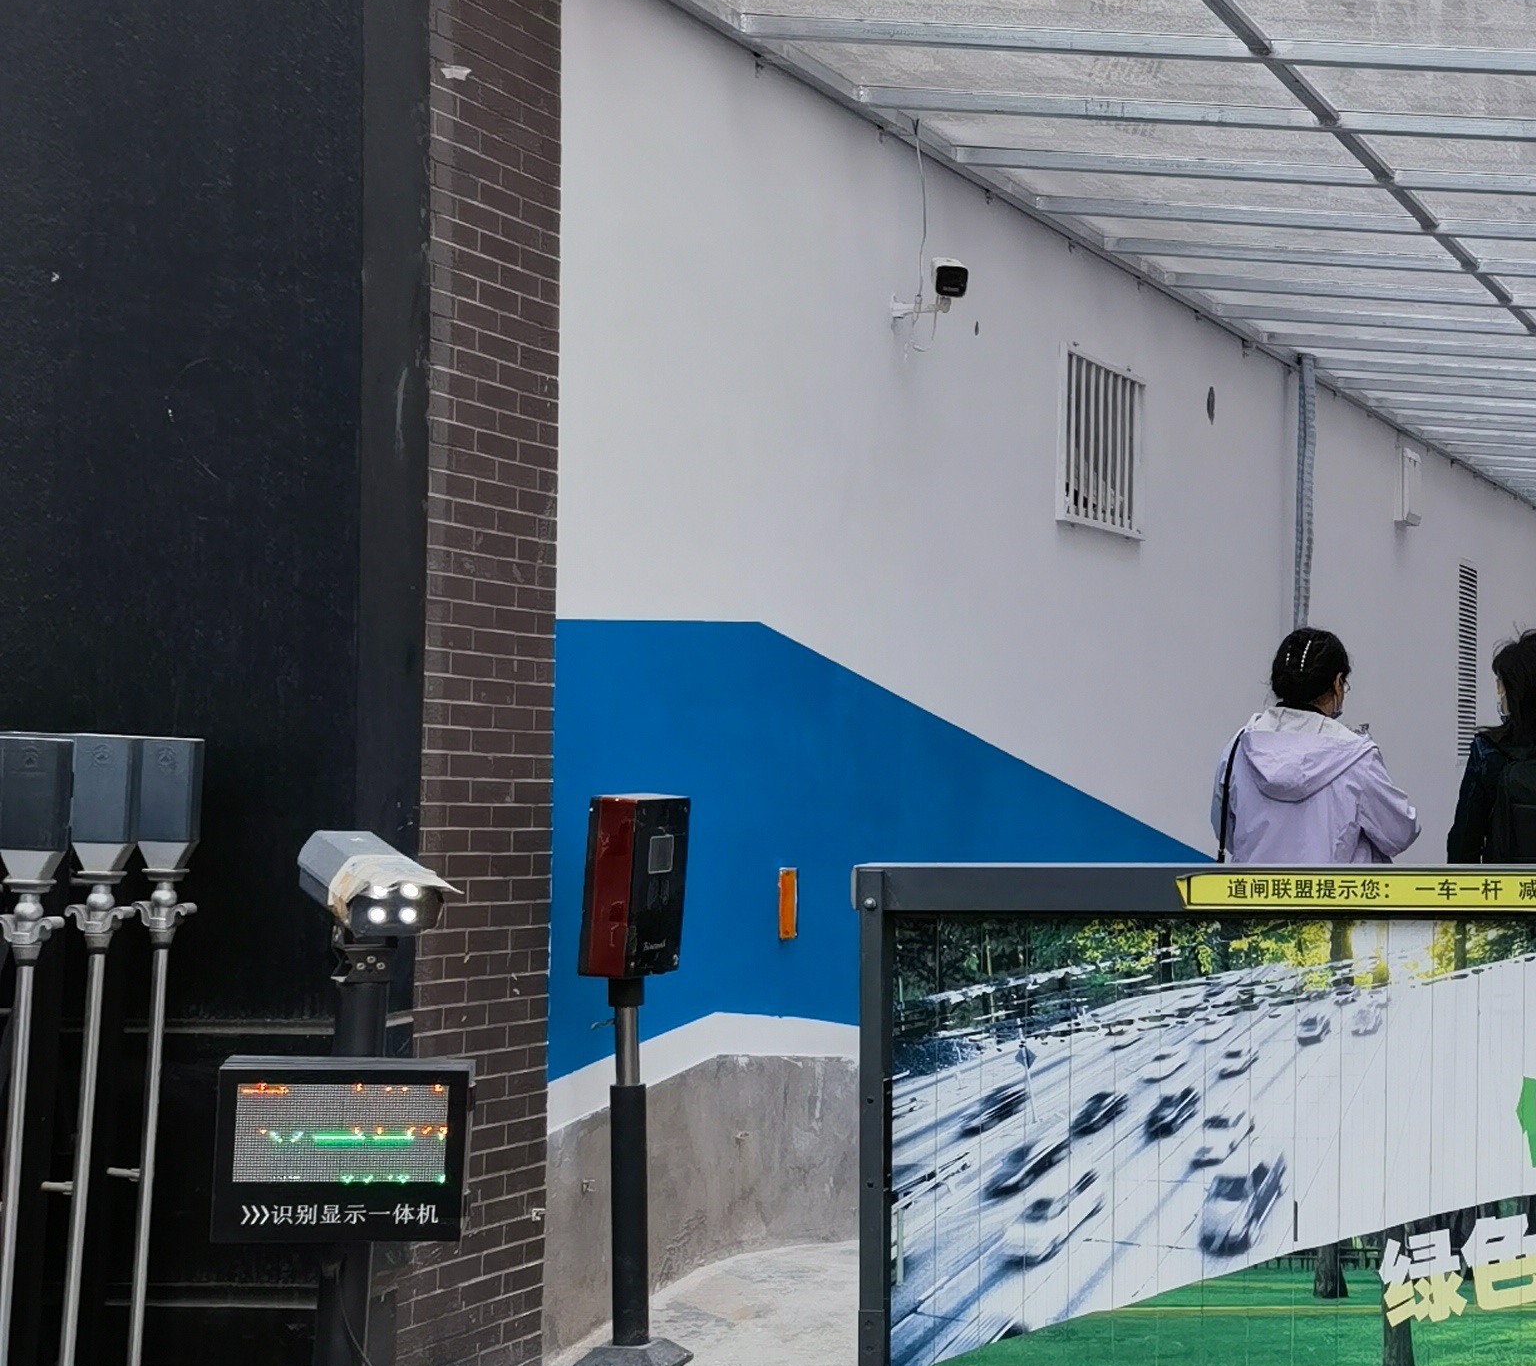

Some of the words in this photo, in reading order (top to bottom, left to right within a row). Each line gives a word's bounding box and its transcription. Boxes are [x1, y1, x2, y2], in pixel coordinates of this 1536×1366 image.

[1227, 878, 1392, 901] 道闸联盟提示您：
[1414, 878, 1504, 901] 一车一杆
[272, 1202, 439, 1225] 识别显示一体机
